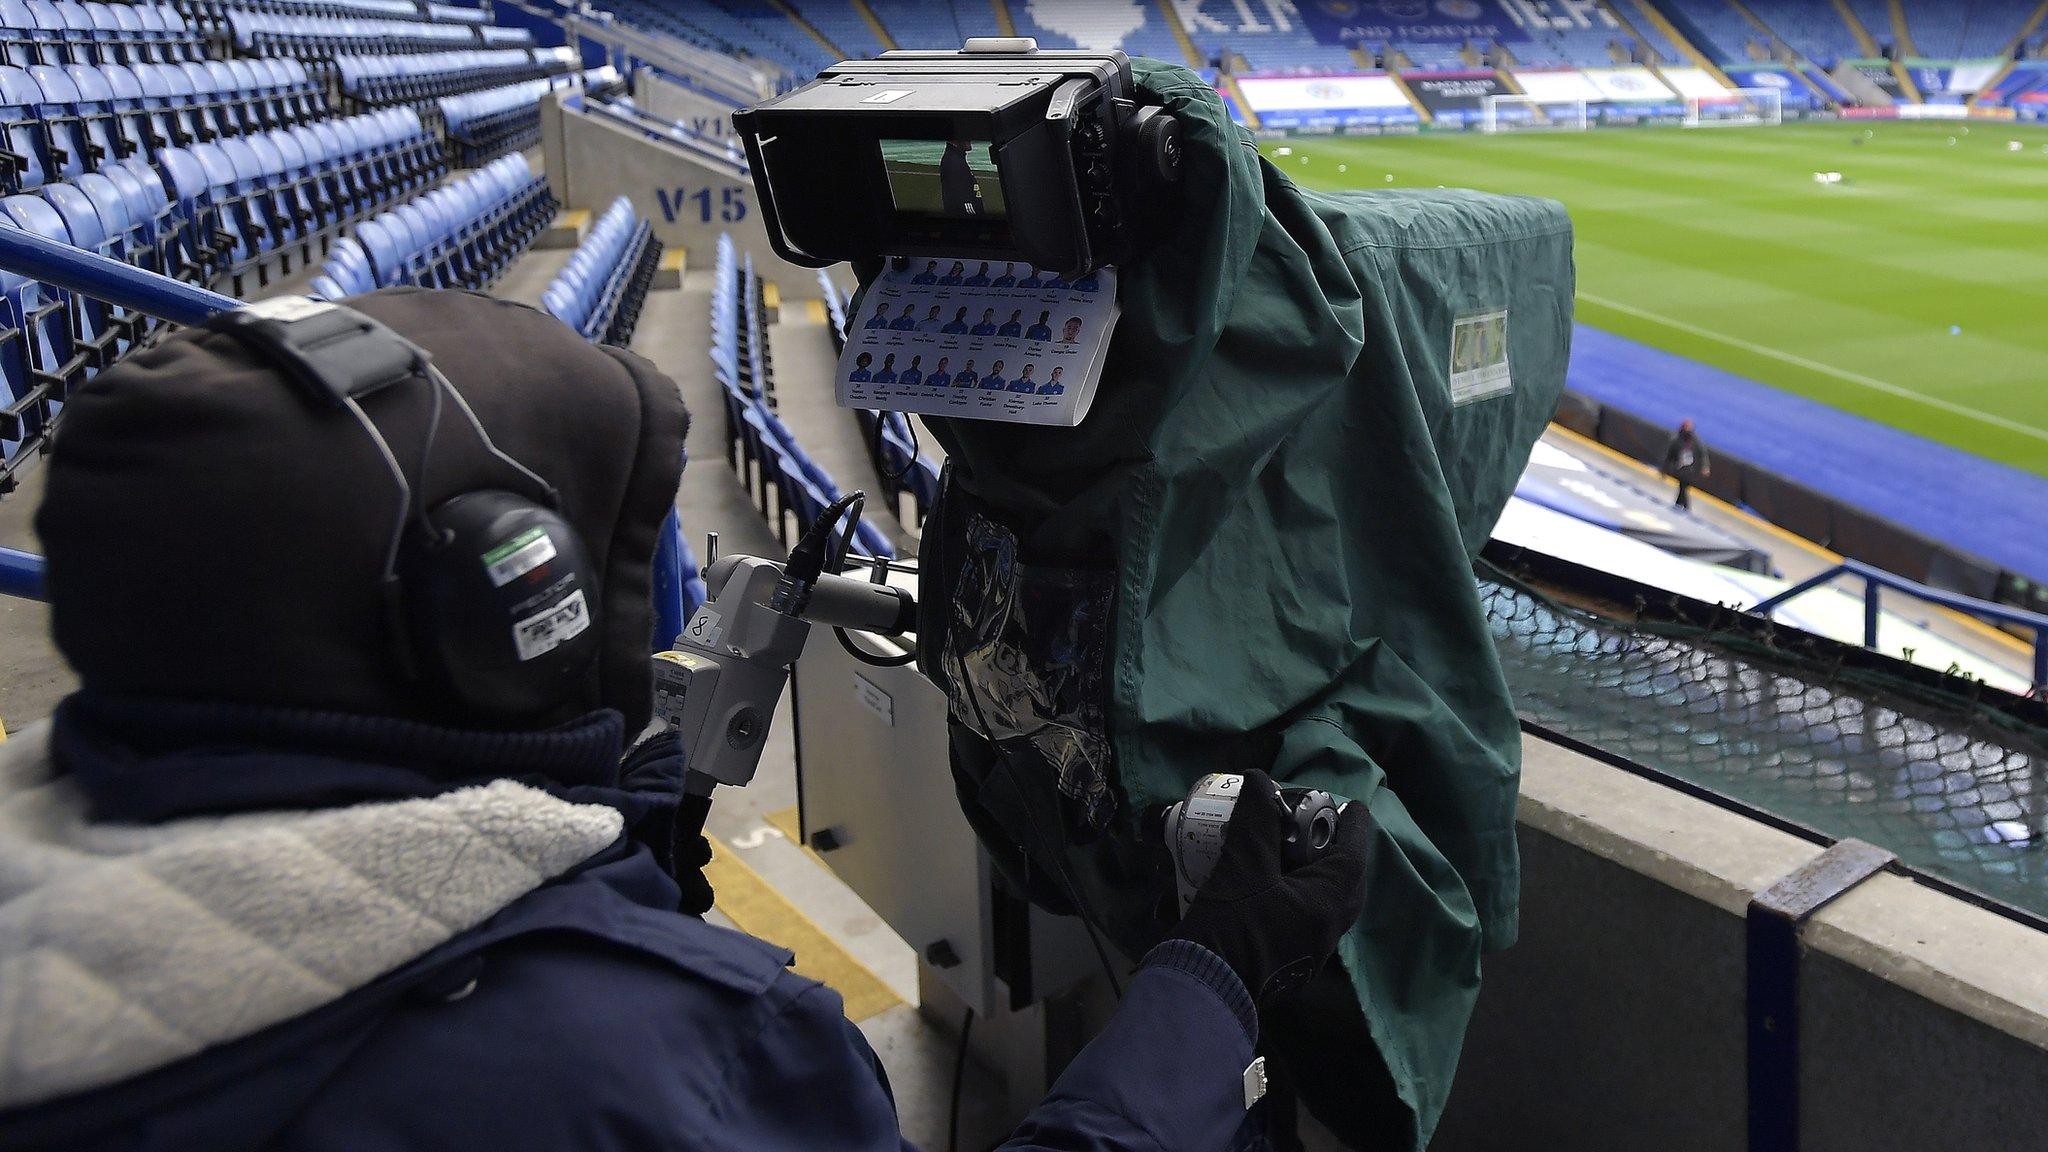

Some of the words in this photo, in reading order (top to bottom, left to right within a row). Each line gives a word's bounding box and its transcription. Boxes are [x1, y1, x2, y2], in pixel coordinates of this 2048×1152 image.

[1339, 25, 1393, 39] AND
[693, 117, 735, 138] V1
[656, 187, 746, 223] V15
[691, 616, 709, 637] 8
[1220, 777, 1240, 790] 8
